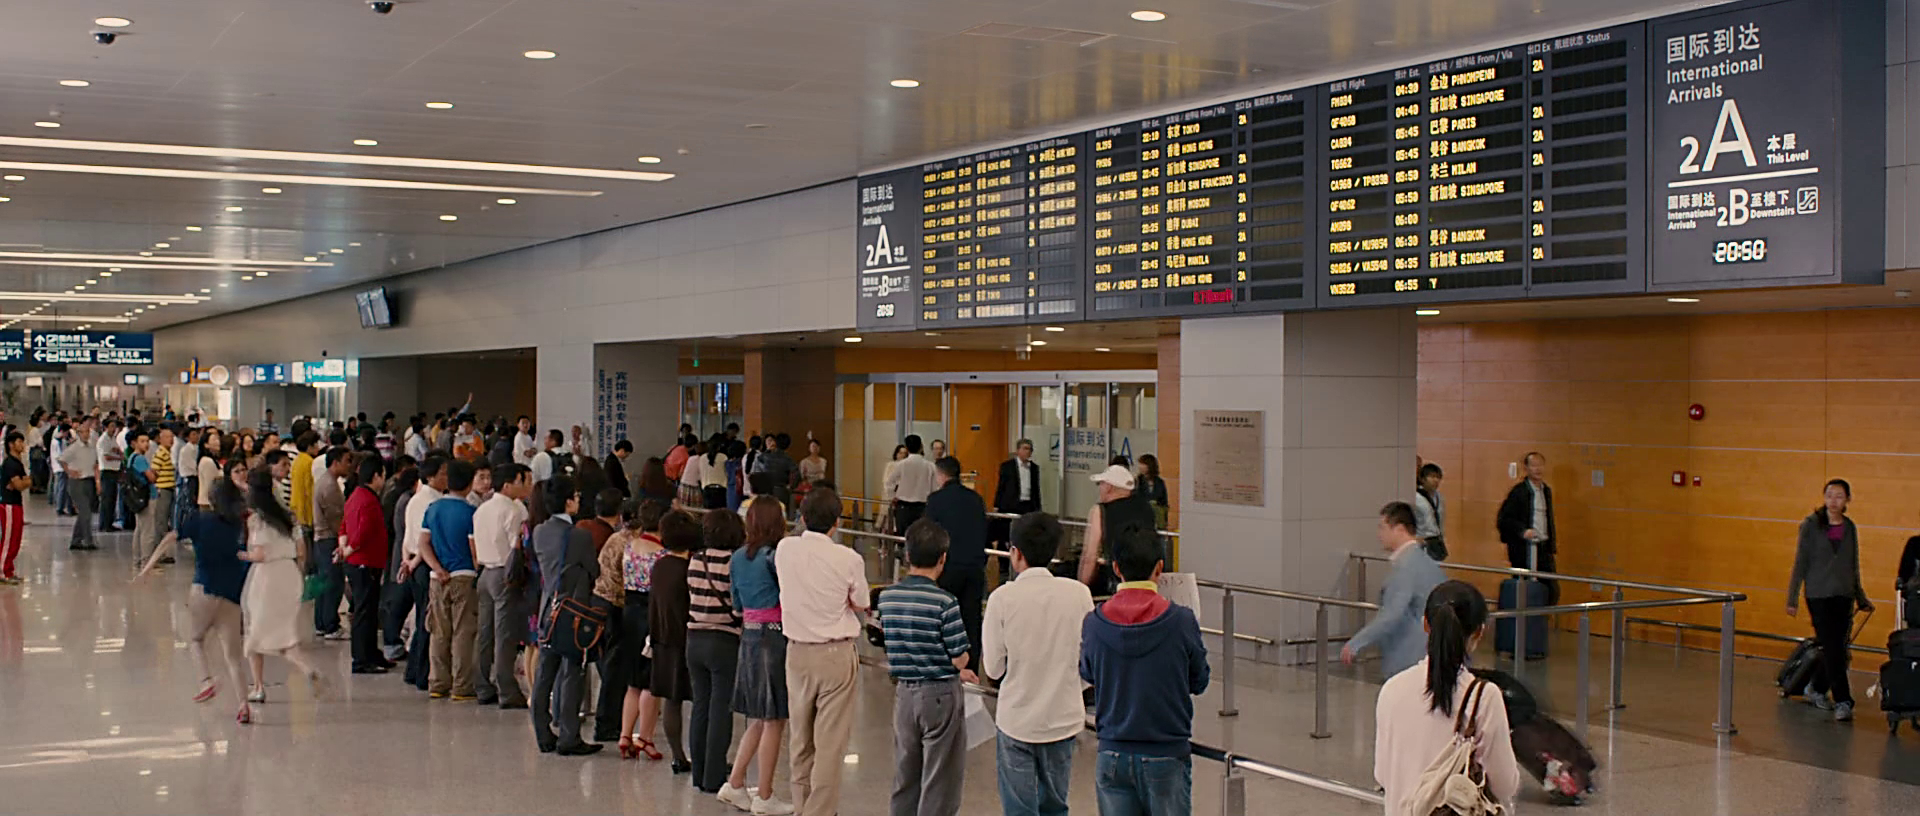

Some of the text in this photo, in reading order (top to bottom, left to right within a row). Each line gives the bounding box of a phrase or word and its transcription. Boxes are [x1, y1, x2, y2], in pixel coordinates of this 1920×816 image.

[1478, 55, 1495, 65] From
[1501, 51, 1513, 60] Via
[1528, 44, 1541, 55] 出口
[1542, 43, 1550, 52] Ex
[1587, 32, 1610, 44] Status
[1667, 22, 1761, 64] 国际到达
[1396, 82, 1418, 96] 04:30
[1431, 74, 1448, 90] 金边
[1452, 68, 1495, 85] PHNOMPENH
[1534, 60, 1543, 71] 2A
[1667, 54, 1763, 84] International
[1668, 82, 1723, 104] Arrivals
[1396, 89, 1504, 117] 04:40 新加坡 SINGAPORE
[1239, 115, 1246, 124] 2A
[1396, 126, 1418, 139] 05:45
[1431, 118, 1448, 134] 巴黎
[1452, 117, 1476, 130] PARIS
[1534, 107, 1544, 118] 2A
[1396, 148, 1418, 161] 05:45
[1431, 141, 1448, 157] 曼谷
[1452, 138, 1485, 153] BANGKOK
[1534, 130, 1543, 141] 2A
[1680, 98, 1757, 175] 2A
[1767, 133, 1796, 152] 本层
[1182, 143, 1196, 153] HONG
[1199, 140, 1213, 150] KONG
[1189, 158, 1219, 171] SINGAPORE
[1239, 154, 1246, 163] 2A
[1766, 150, 1809, 165] This Level
[1355, 178, 1360, 186] /
[1396, 170, 1418, 182] 05:50
[1431, 162, 1448, 179] 米兰
[1452, 162, 1476, 175] MILAN
[1534, 154, 1543, 165] 2A
[1189, 180, 1199, 190] SAN
[1202, 175, 1233, 188] FRANCISCO
[1239, 173, 1246, 183] 2A
[1238, 193, 1246, 203] 2A
[1396, 181, 1504, 204] 05:50 新加坡 SINGAPORE
[1668, 192, 1716, 210] 国际到达
[1750, 190, 1789, 208] 至楼下
[1396, 201, 1544, 225] 06:00 2A
[1668, 208, 1716, 221] International
[1717, 188, 1749, 227] 2B
[1750, 206, 1795, 219] Downstairs
[1182, 218, 1198, 228] DUBAI
[1239, 212, 1246, 222] 2A
[1668, 220, 1696, 230] Arrivals
[1182, 237, 1196, 247] HONG
[1198, 235, 1212, 245] KONG
[1238, 232, 1246, 242] 2A
[1396, 235, 1418, 247] 06:30
[1430, 230, 1448, 245] 曼谷
[1452, 229, 1485, 242] BANGKOK
[1534, 224, 1544, 235] 2A
[866, 224, 893, 267] 2A
[1714, 240, 1765, 263] 20:50
[1188, 255, 1209, 265] MANILA
[1238, 252, 1246, 261] 2A
[1395, 257, 1418, 269] 06:35
[1430, 251, 1457, 267] 新加坡
[1462, 250, 1504, 264] SINGAPORE
[1534, 248, 1544, 259] 2A
[1181, 275, 1196, 284] HONG
[1198, 274, 1212, 283] KONG
[1238, 271, 1246, 281] 2A
[1395, 279, 1418, 291] 06:55
[1067, 431, 1105, 447] 国际到达
